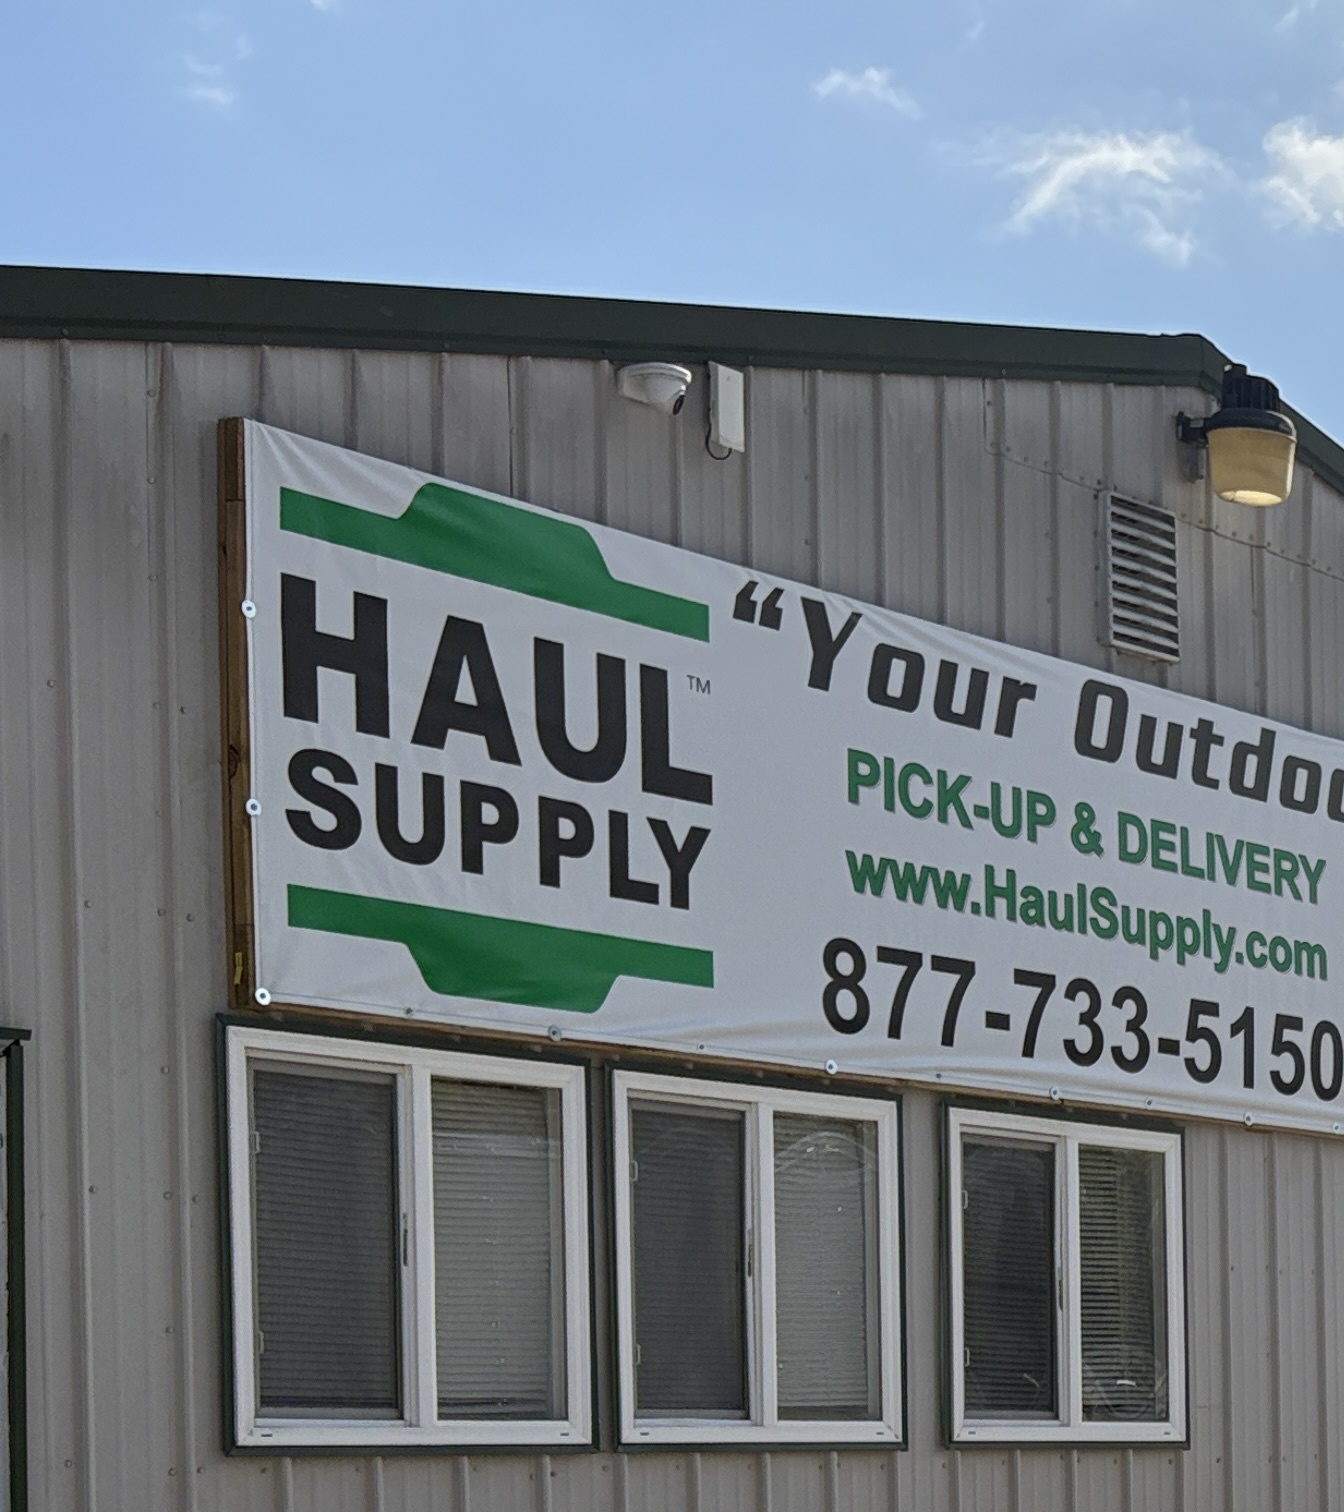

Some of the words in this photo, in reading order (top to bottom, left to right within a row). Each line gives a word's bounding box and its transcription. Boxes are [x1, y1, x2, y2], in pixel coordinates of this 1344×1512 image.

[280, 572, 713, 806] HAUL
[286, 748, 712, 910] SUPPLY
[846, 748, 1056, 843] PICK-UP
[1070, 801, 1104, 857] &
[1117, 811, 1326, 904] DELIVERY
[845, 850, 1328, 980] www.HaulSupply.com
[821, 937, 1344, 1101] 877-733-5150
